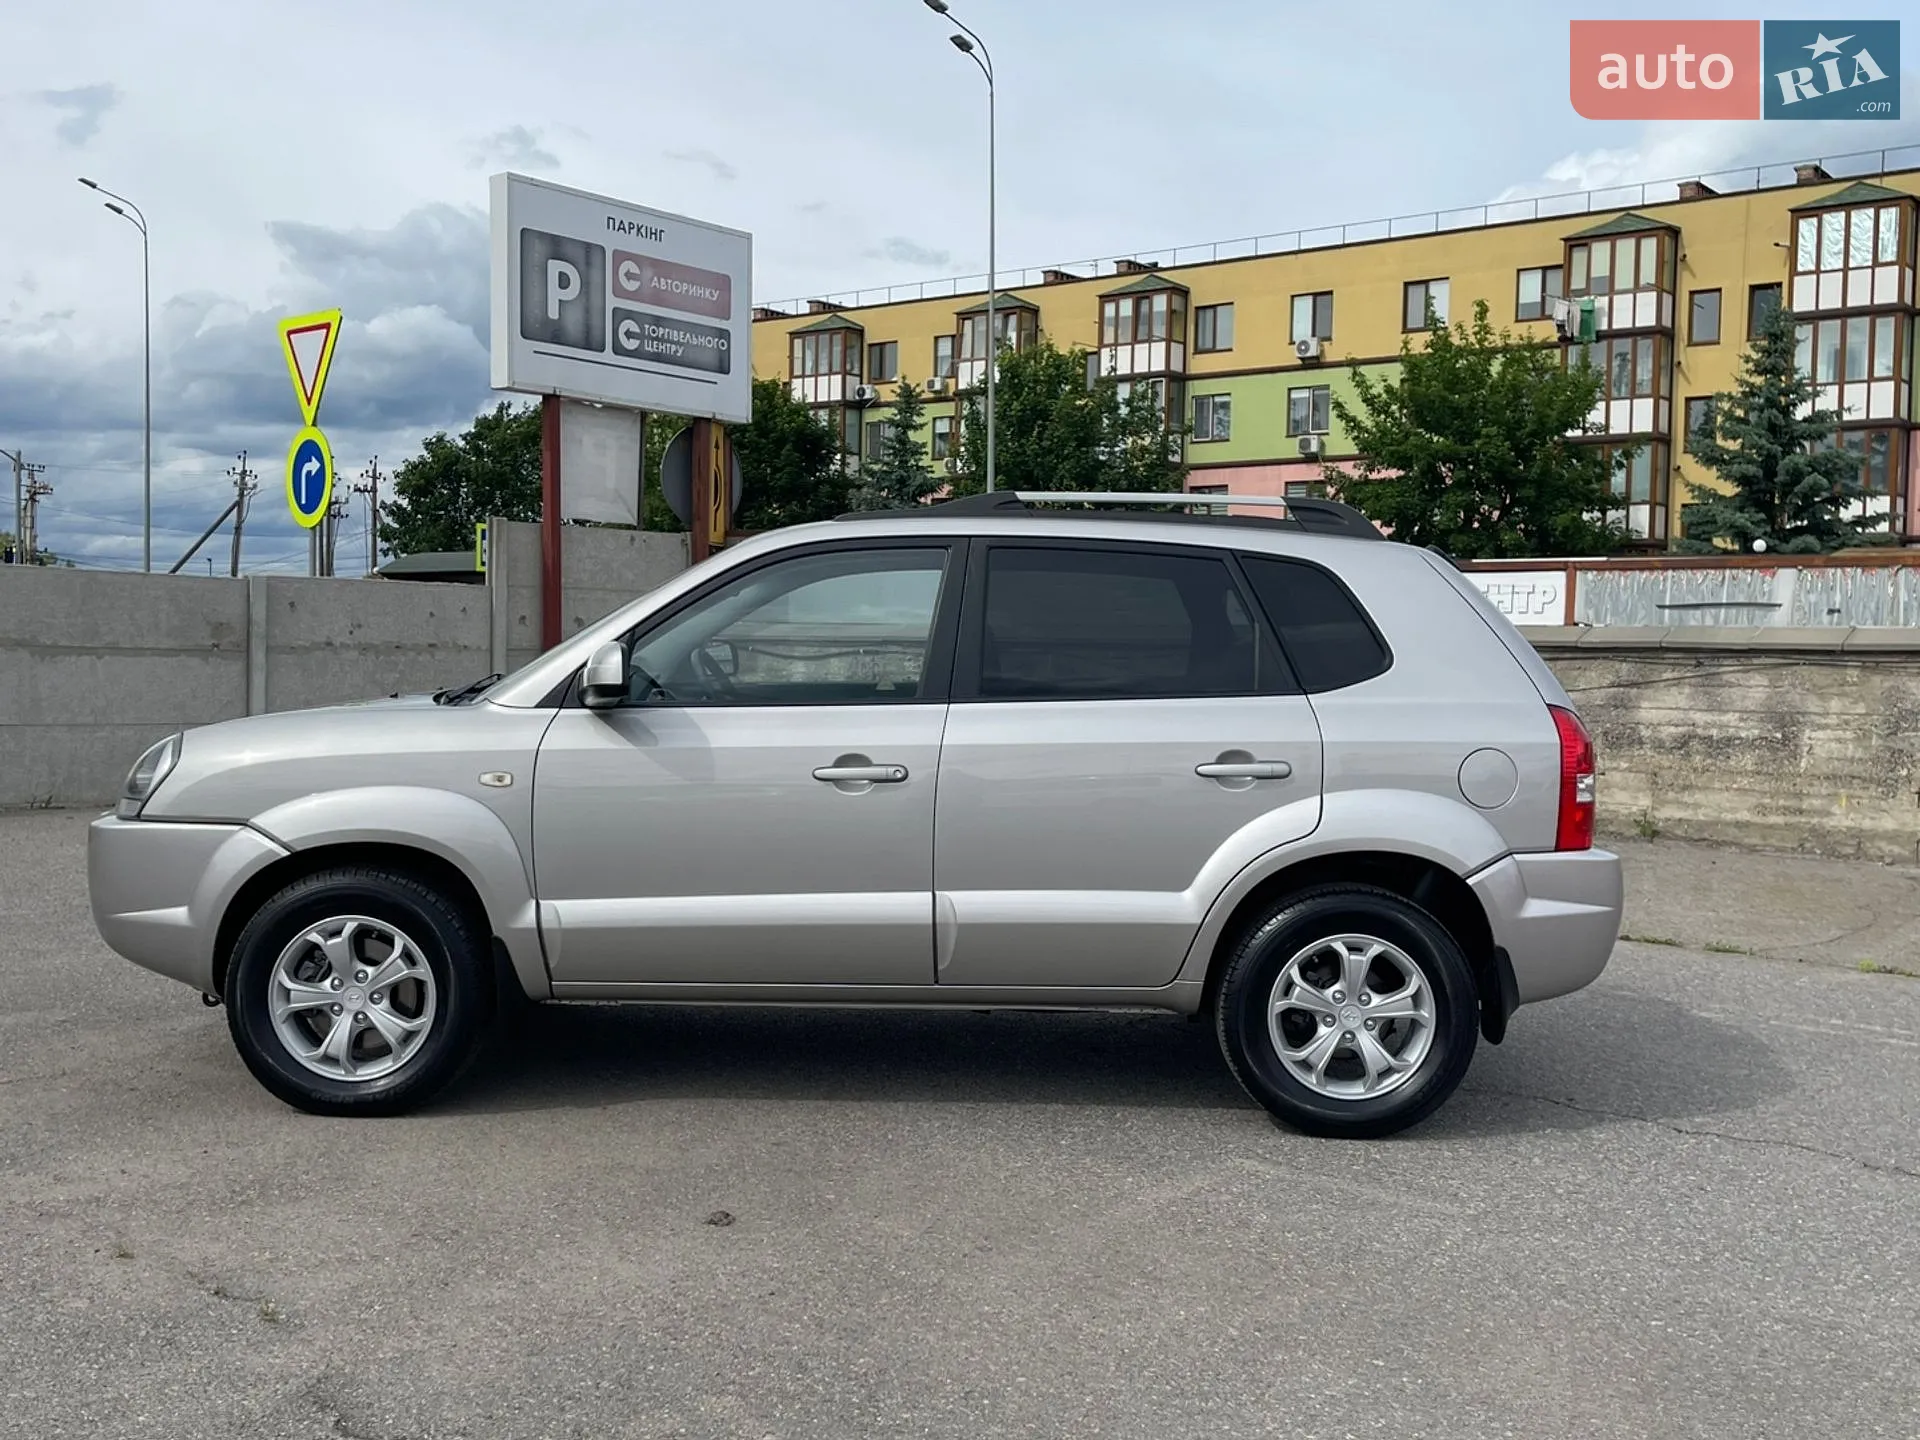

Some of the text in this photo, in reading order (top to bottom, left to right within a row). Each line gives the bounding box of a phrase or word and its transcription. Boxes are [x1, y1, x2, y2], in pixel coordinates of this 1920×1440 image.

[606, 216, 666, 243] ПАРКІНГ
[546, 258, 582, 320] P
[651, 276, 720, 301] АВТОРИНКУ
[644, 324, 728, 350] ТОРГІВЕЛЬНОГО
[644, 340, 684, 357] ЦЕНТРУ
